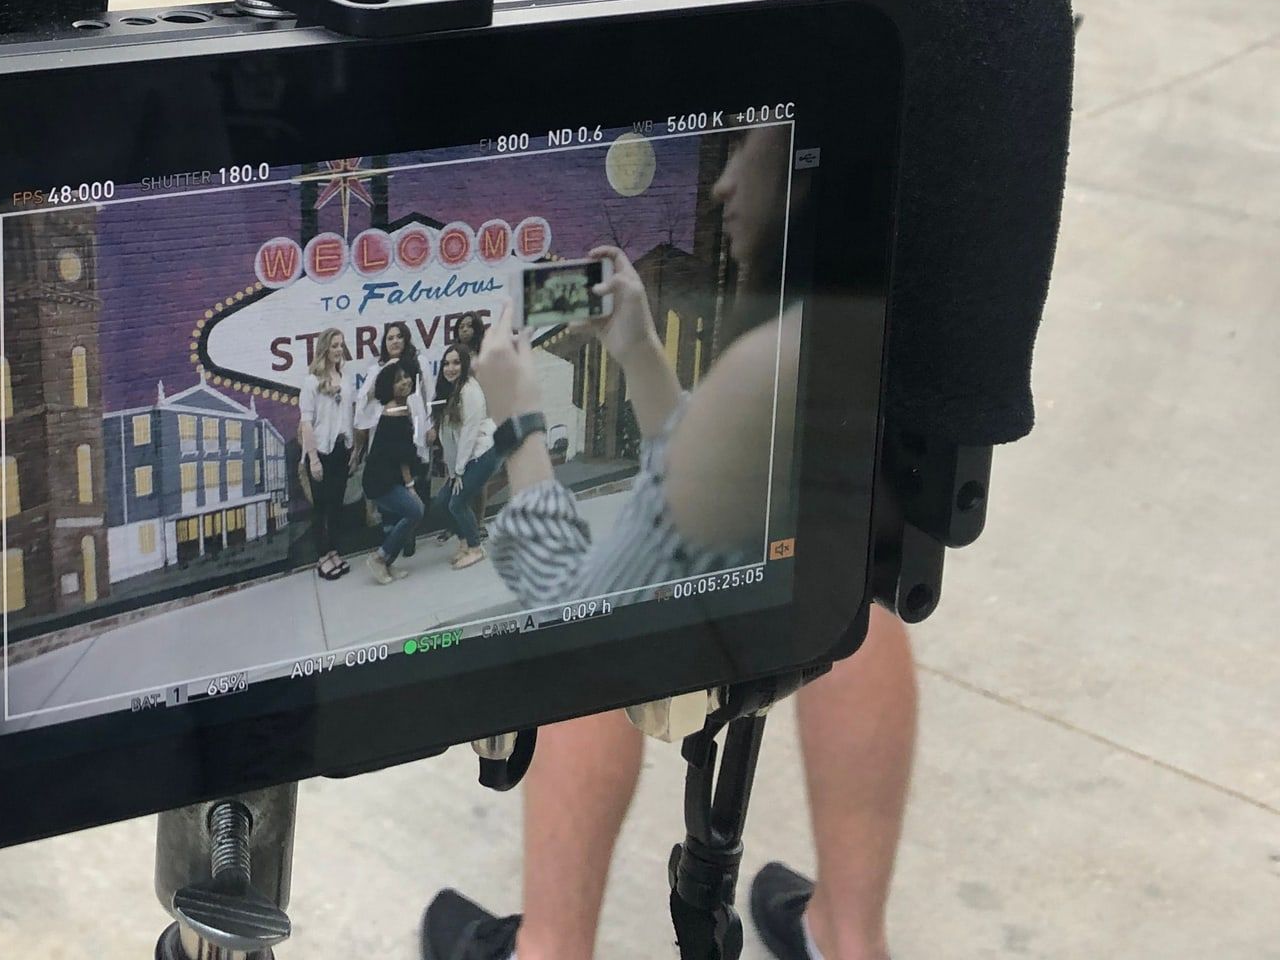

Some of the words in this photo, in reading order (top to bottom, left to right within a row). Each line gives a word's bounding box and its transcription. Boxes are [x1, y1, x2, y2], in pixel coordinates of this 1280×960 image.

[667, 112, 707, 133] 5600
[712, 110, 724, 127] K
[736, 105, 770, 124] +0.0
[775, 102, 795, 120] CC
[497, 133, 529, 153] 800
[548, 129, 572, 147] ND
[578, 125, 603, 143] 0.6
[141, 170, 211, 192] SHUTTER
[218, 162, 270, 185] 180.0
[13, 190, 43, 207] FPS
[47, 180, 115, 205] 48.000
[264, 226, 543, 279] WELCOME
[320, 294, 350, 312] TO
[358, 274, 504, 315] Fabulous
[673, 567, 764, 599] 00:05:25:05
[523, 614, 535, 630] A
[562, 601, 597, 622] 0:09
[602, 599, 611, 614] h
[419, 629, 464, 653] STBY
[290, 654, 337, 679] A017
[345, 644, 389, 668] C000
[131, 692, 161, 712] BAT
[206, 674, 246, 696] 65%
